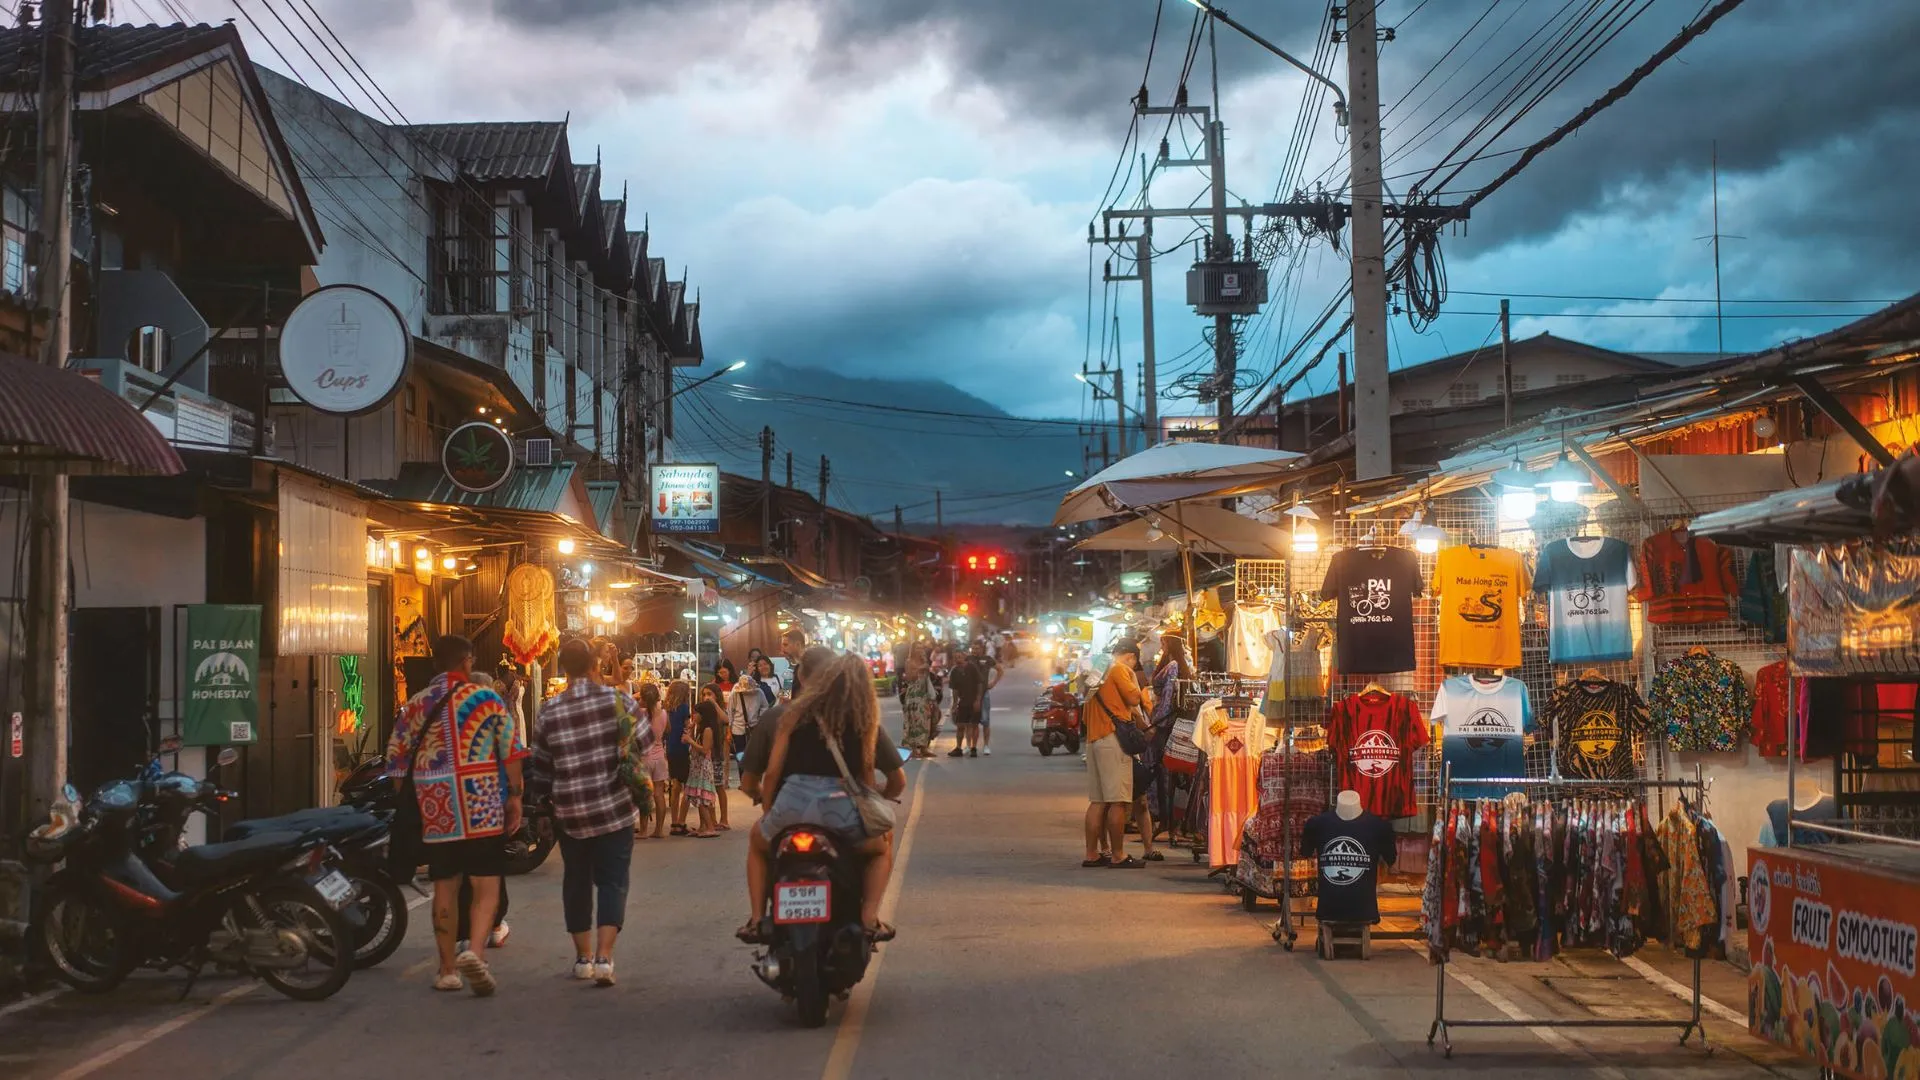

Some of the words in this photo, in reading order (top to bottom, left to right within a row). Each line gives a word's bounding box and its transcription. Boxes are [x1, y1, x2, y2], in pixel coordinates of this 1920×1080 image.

[313, 368, 370, 391] Cups
[1456, 577, 1471, 585] Mae
[1473, 577, 1492, 587] Hong
[1494, 578, 1508, 587] Son
[1584, 572, 1605, 584] PAI
[1368, 579, 1391, 591] PAI
[1367, 615, 1380, 623] 762
[193, 640, 216, 649] PAI
[219, 640, 254, 649] BAAN
[192, 690, 251, 699] HOMESTAY
[785, 907, 821, 918] 9583
[1794, 904, 1831, 944] FRUIT
[1838, 915, 1916, 971] SMOOTHIE
